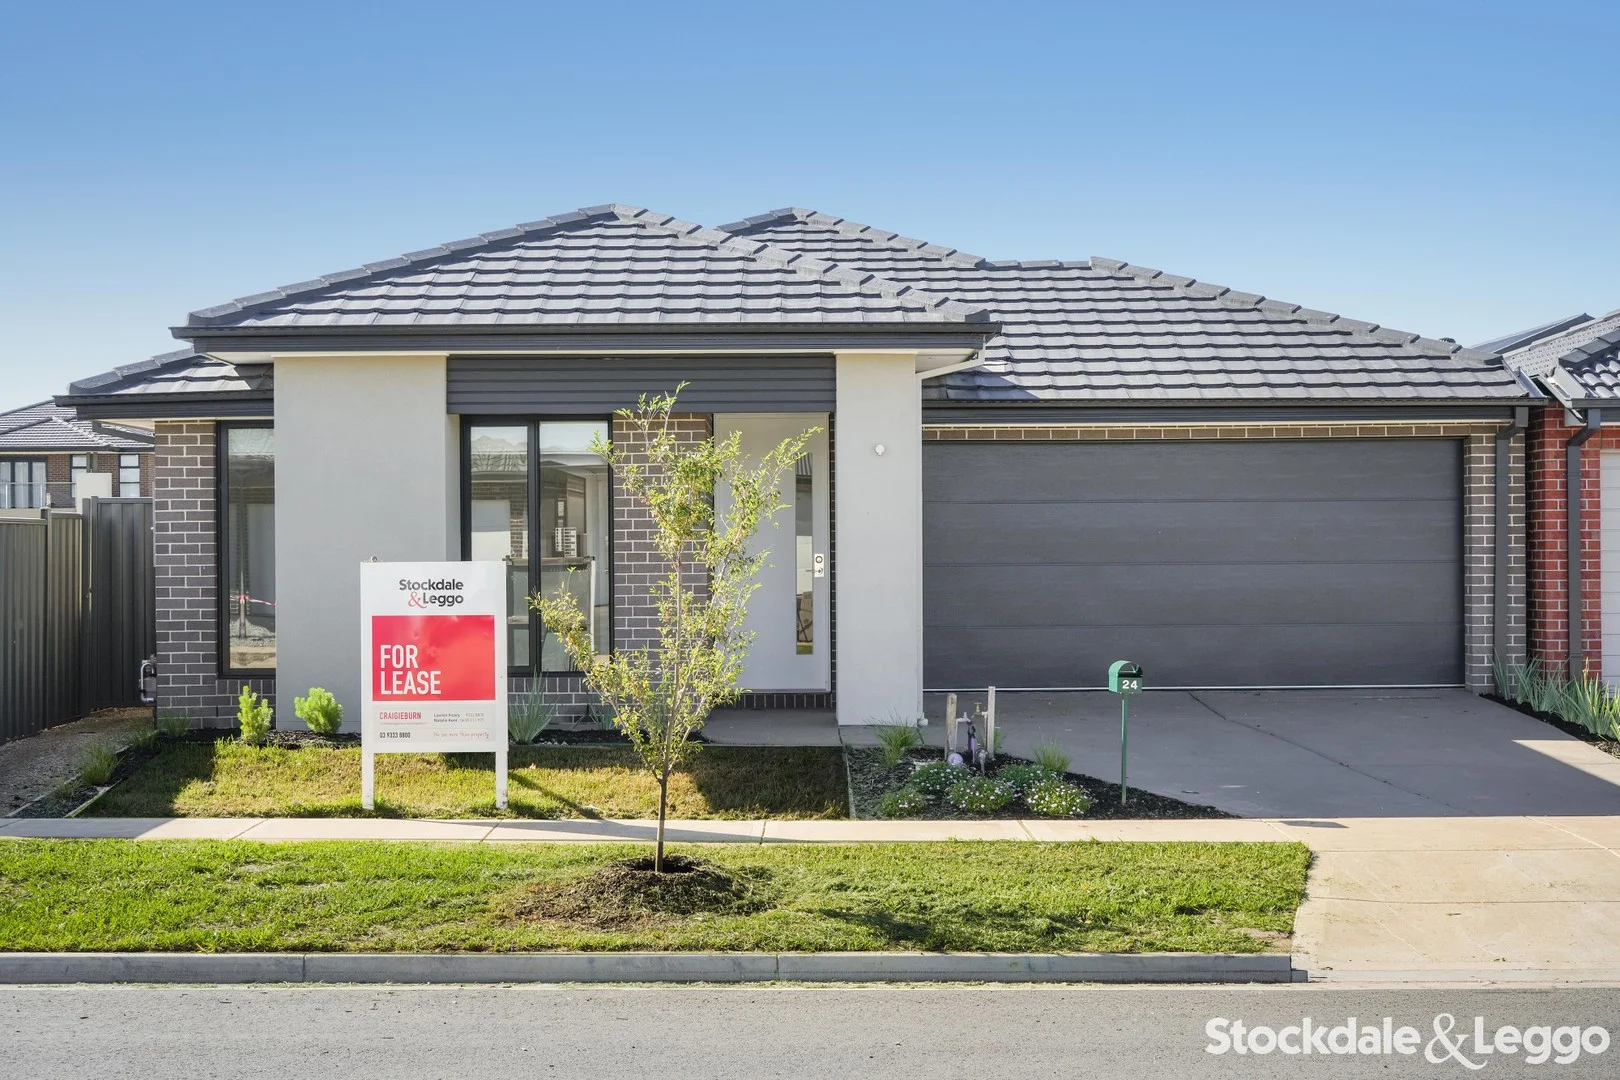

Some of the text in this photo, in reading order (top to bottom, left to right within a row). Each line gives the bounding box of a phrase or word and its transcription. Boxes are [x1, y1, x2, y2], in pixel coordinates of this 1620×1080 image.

[399, 578, 464, 591] Stockdale
[380, 644, 419, 669] FOR
[380, 670, 441, 695] LEASE
[1122, 679, 1138, 690] 24
[380, 712, 422, 720] CRAIGIEBURN
[379, 731, 411, 739] 03 9333 8800
